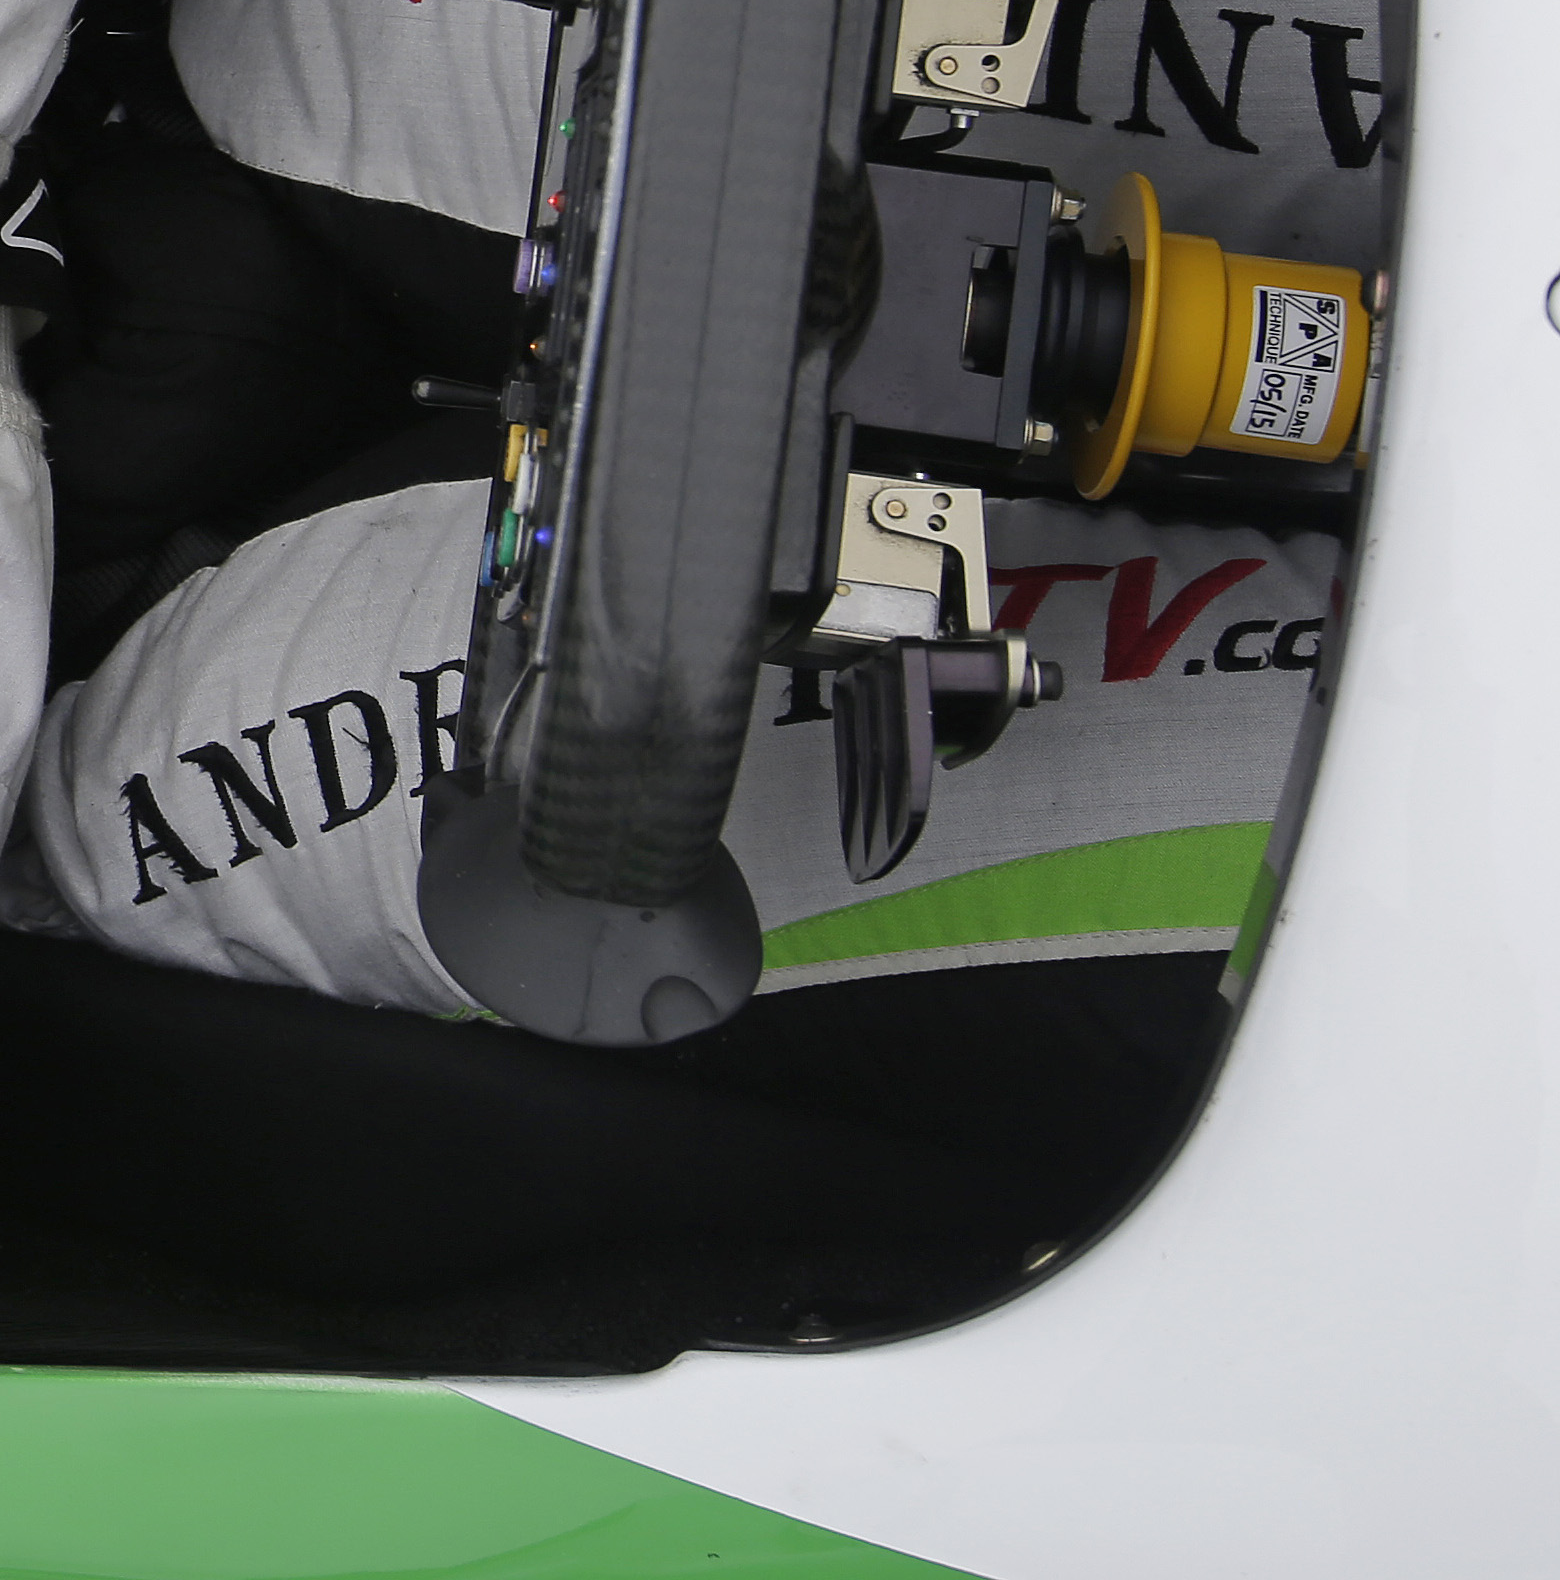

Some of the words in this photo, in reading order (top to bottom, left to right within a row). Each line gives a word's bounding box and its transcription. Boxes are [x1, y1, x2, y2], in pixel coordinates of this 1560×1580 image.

[1264, 292, 1283, 365] TECHNIQUE
[1299, 299, 1337, 369] SPA
[1249, 373, 1288, 429] 05/15
[1297, 374, 1319, 407] MFG.
[1287, 410, 1310, 440] DATE
